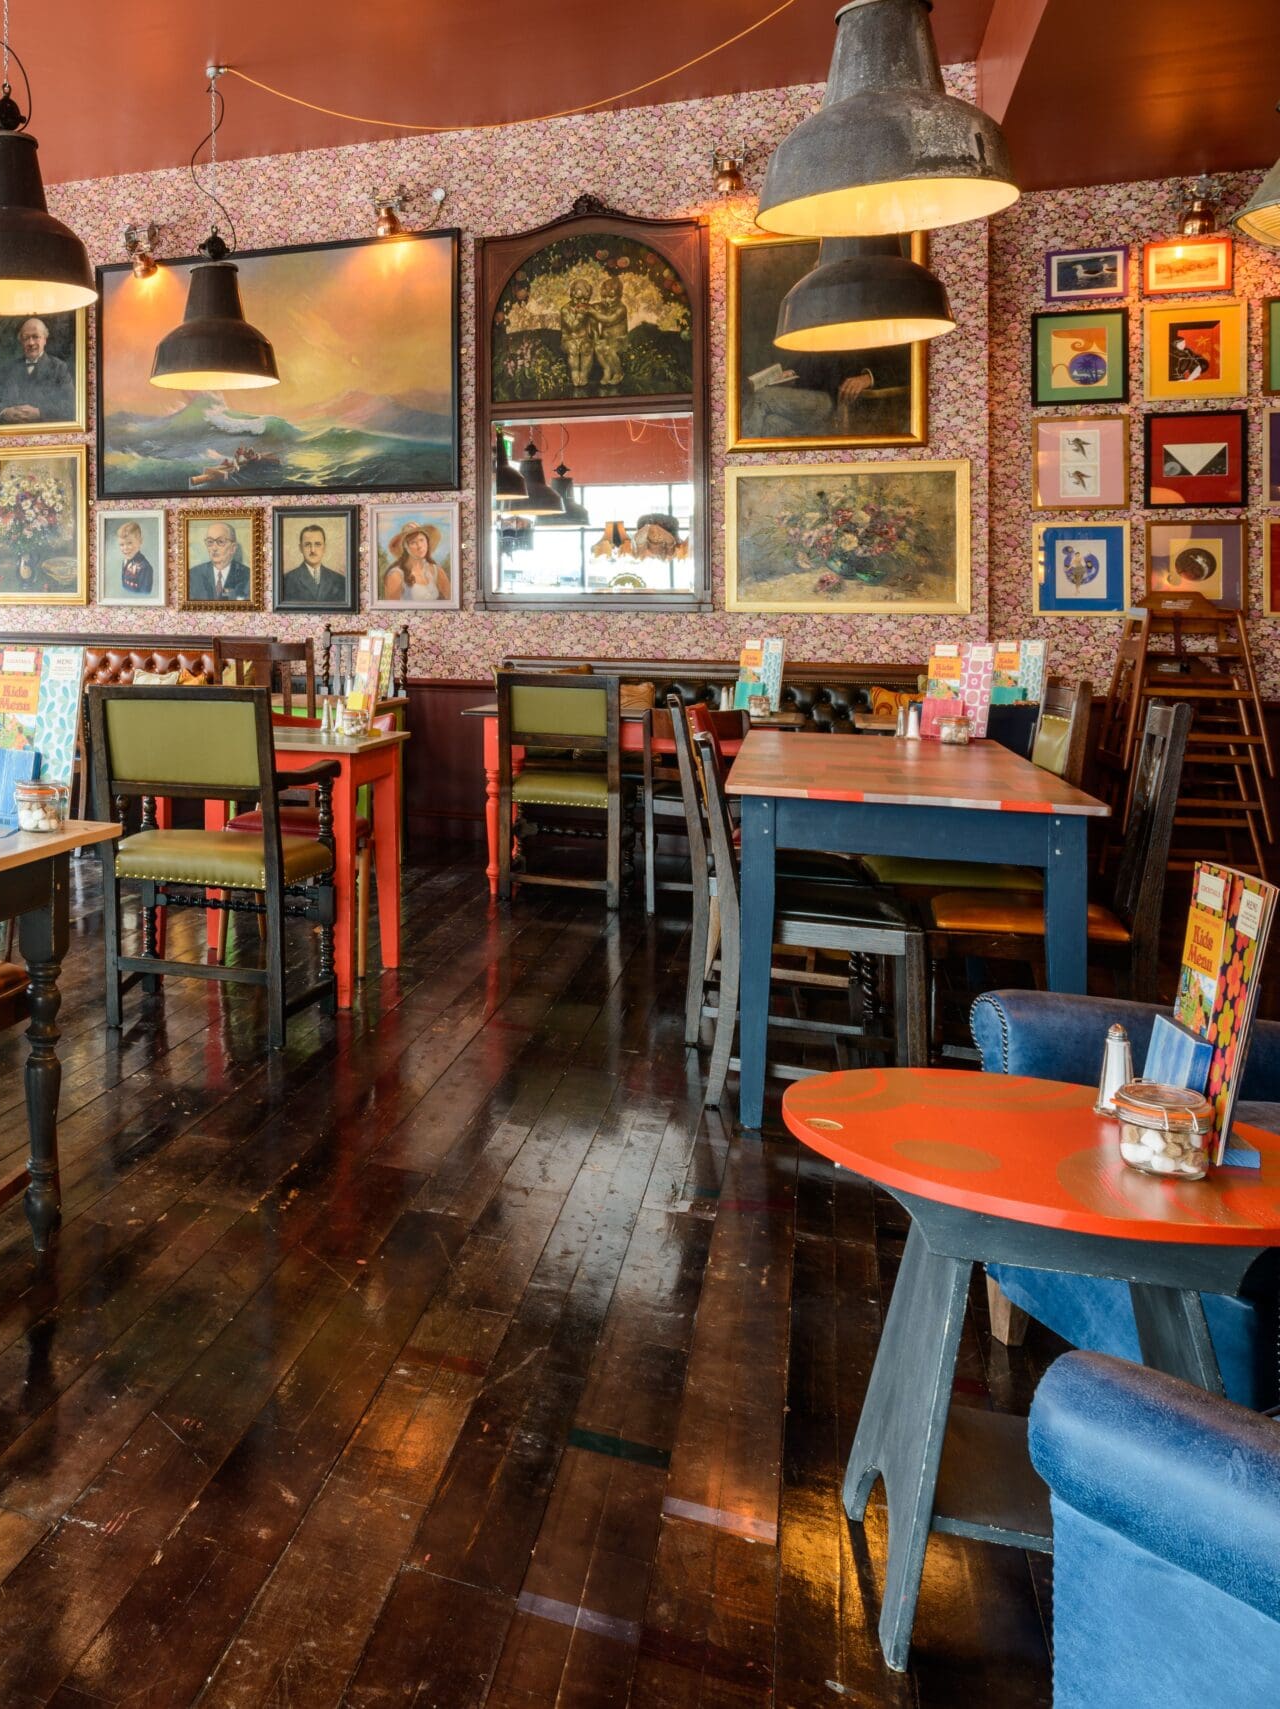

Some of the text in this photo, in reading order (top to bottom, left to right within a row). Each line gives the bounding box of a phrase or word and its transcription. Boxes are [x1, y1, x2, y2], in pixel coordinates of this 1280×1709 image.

[2, 684, 29, 698] Kids
[1193, 924, 1214, 952] Kids
[1186, 943, 1213, 973] Menu
